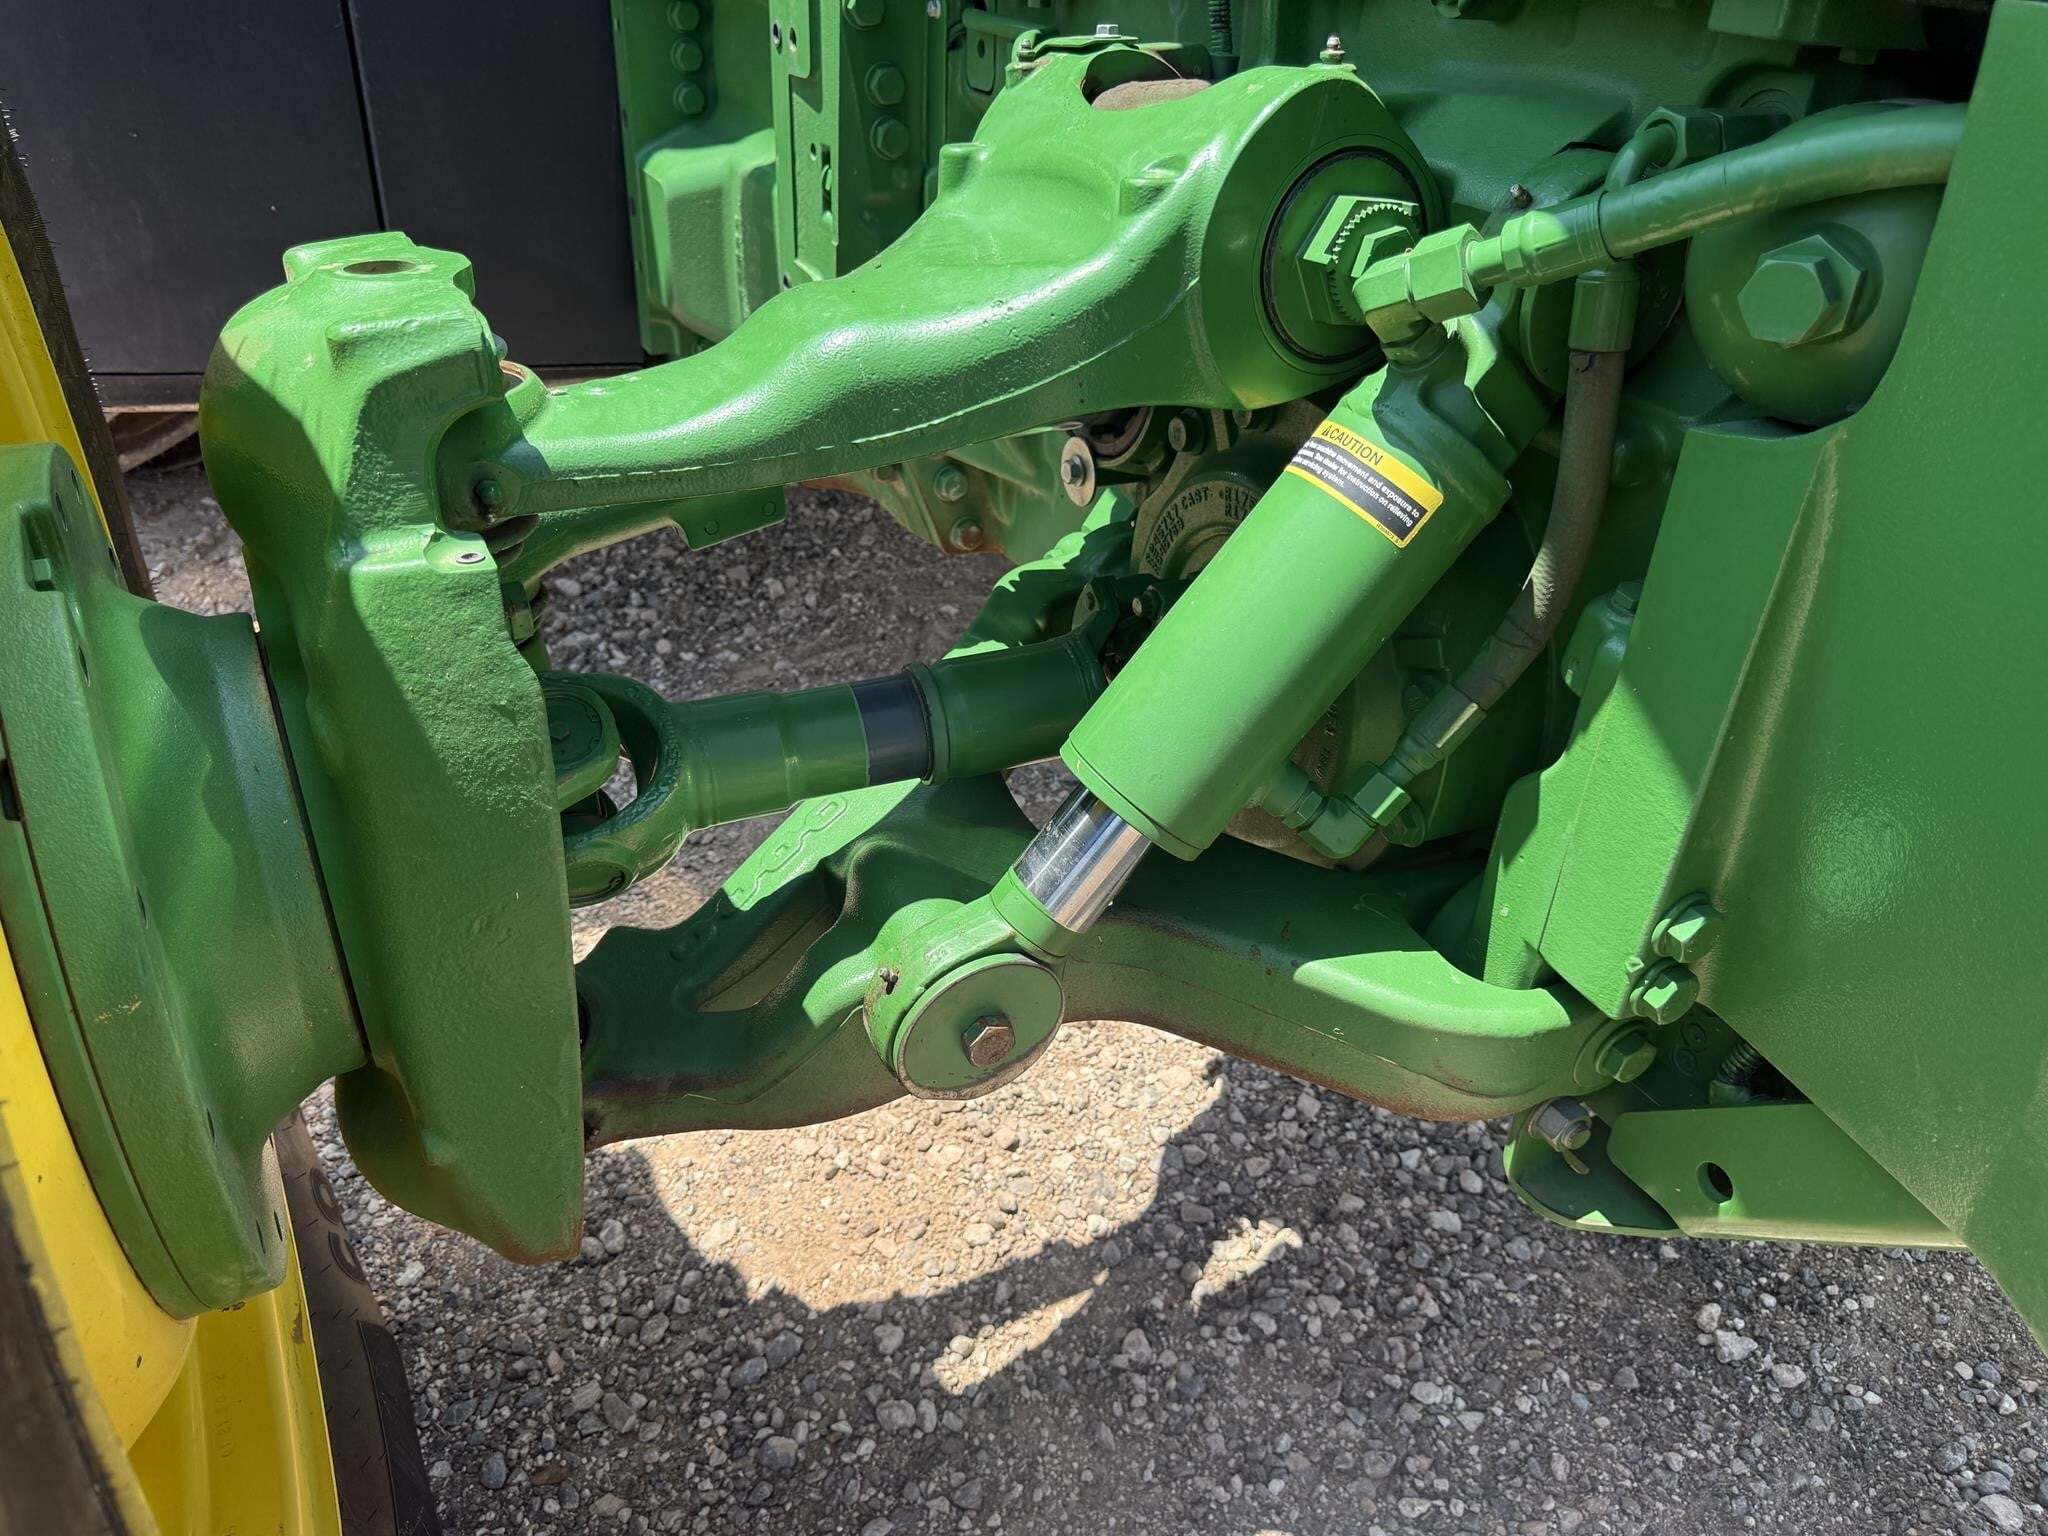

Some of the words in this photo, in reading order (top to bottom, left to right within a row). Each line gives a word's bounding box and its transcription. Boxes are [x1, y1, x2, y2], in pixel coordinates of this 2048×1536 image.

[1328, 428, 1383, 466] CAUTION
[1320, 469, 1344, 488] system.
[1334, 453, 1369, 480] movement
[1366, 475, 1382, 489] and
[1379, 485, 1413, 512] exposure
[1410, 507, 1420, 519] to
[1336, 466, 1348, 477] for
[1345, 473, 1380, 500] instruction
[1377, 496, 1388, 506] on
[1385, 502, 1414, 527] relieving
